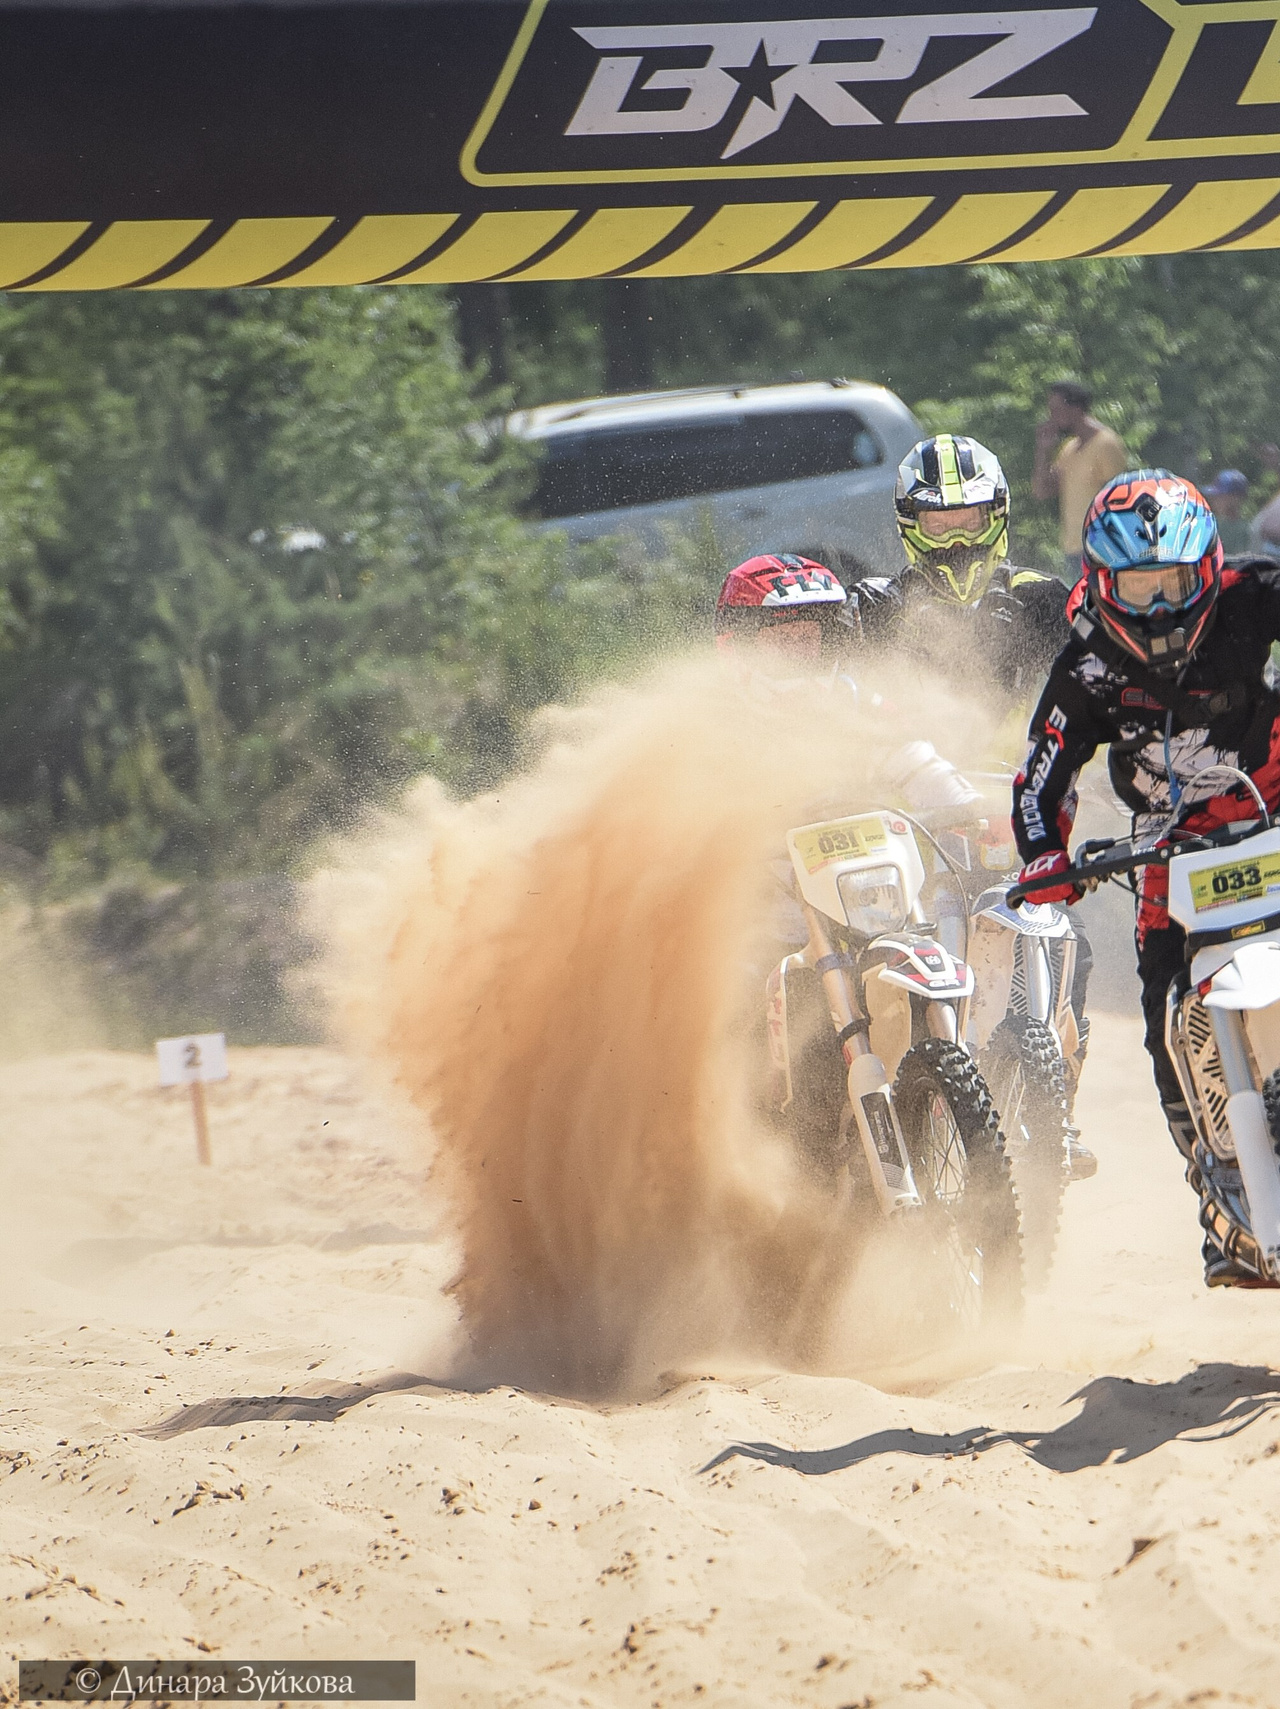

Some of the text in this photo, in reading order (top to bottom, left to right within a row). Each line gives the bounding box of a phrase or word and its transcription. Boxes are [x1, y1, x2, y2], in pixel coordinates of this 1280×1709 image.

[768, 569, 833, 598] FLY
[1211, 865, 1263, 895] 033
[183, 1043, 202, 1070] 2
